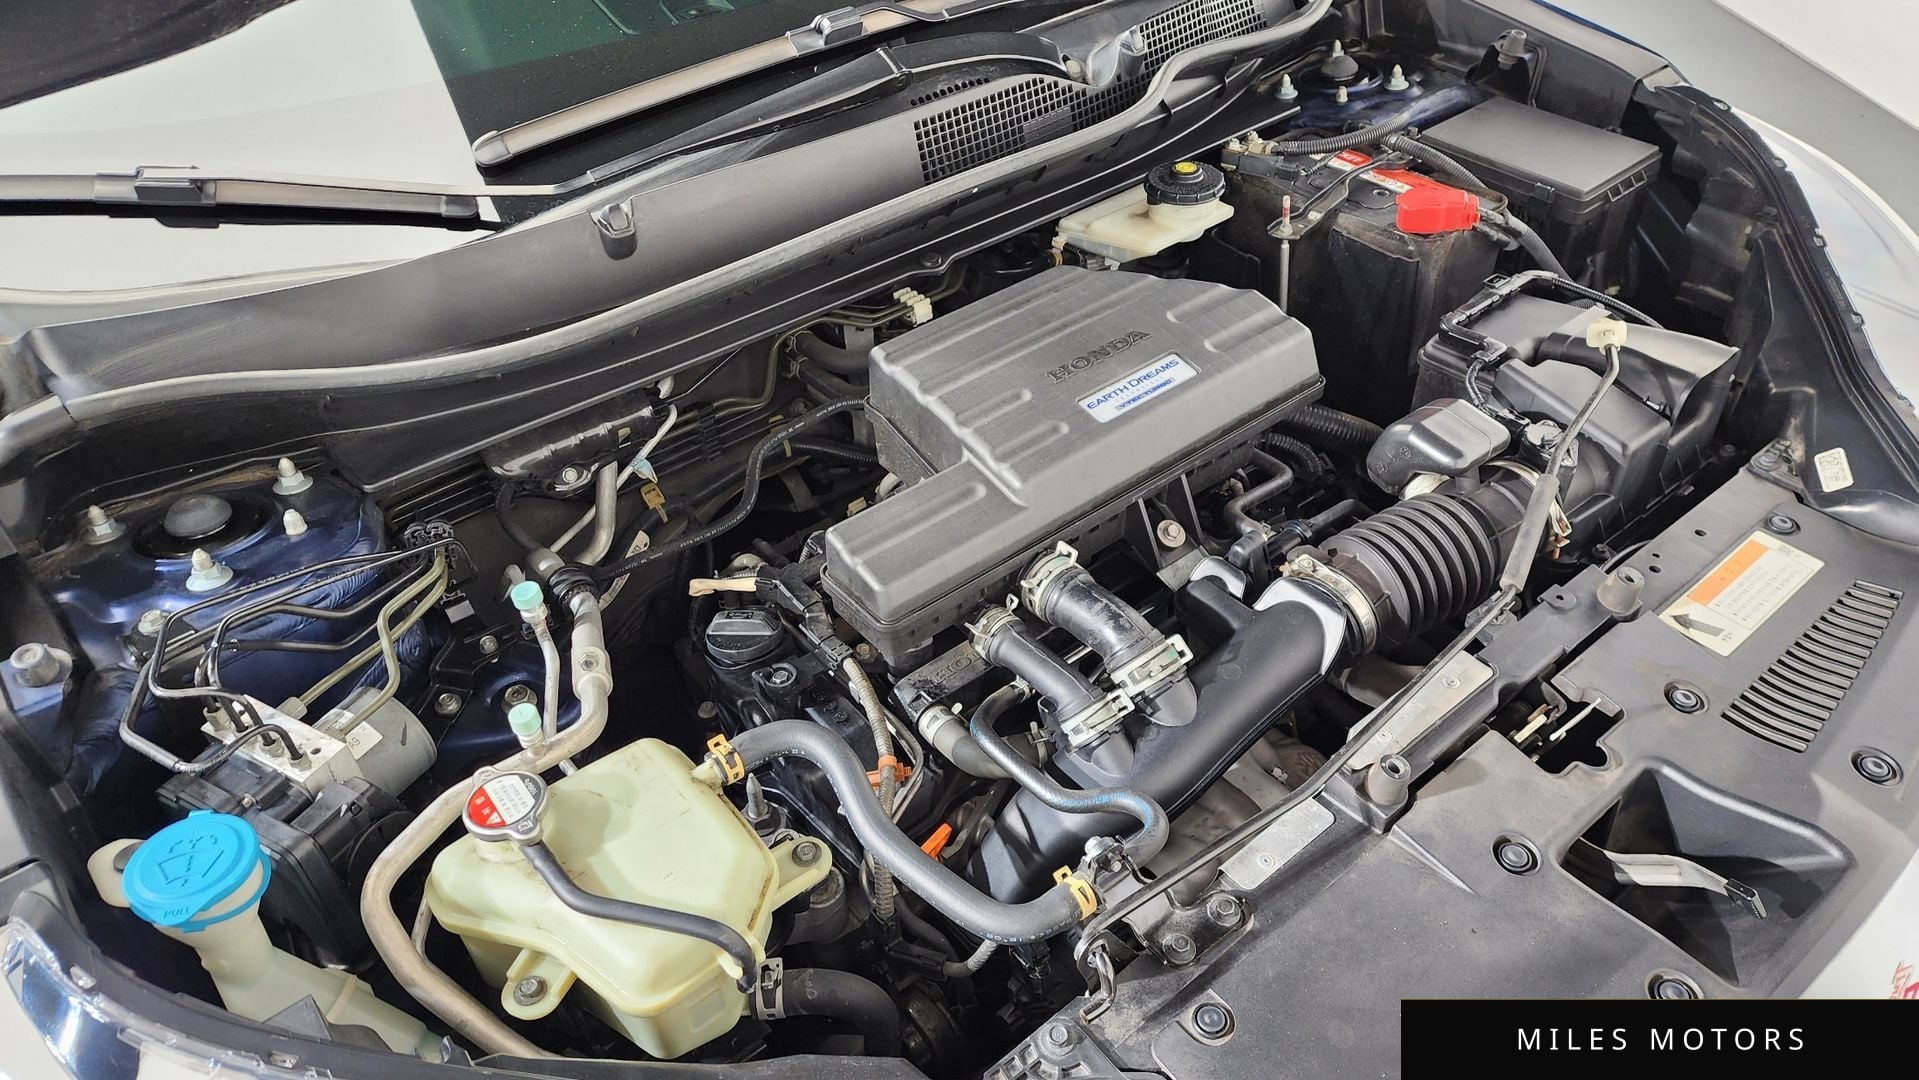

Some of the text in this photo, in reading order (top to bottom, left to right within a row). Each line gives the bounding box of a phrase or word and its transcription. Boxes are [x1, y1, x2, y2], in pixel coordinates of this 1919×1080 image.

[1046, 330, 1152, 383] HONDA
[1087, 384, 1130, 409] EARTH
[1128, 359, 1180, 388] DREAMS
[163, 906, 191, 919] PULL
